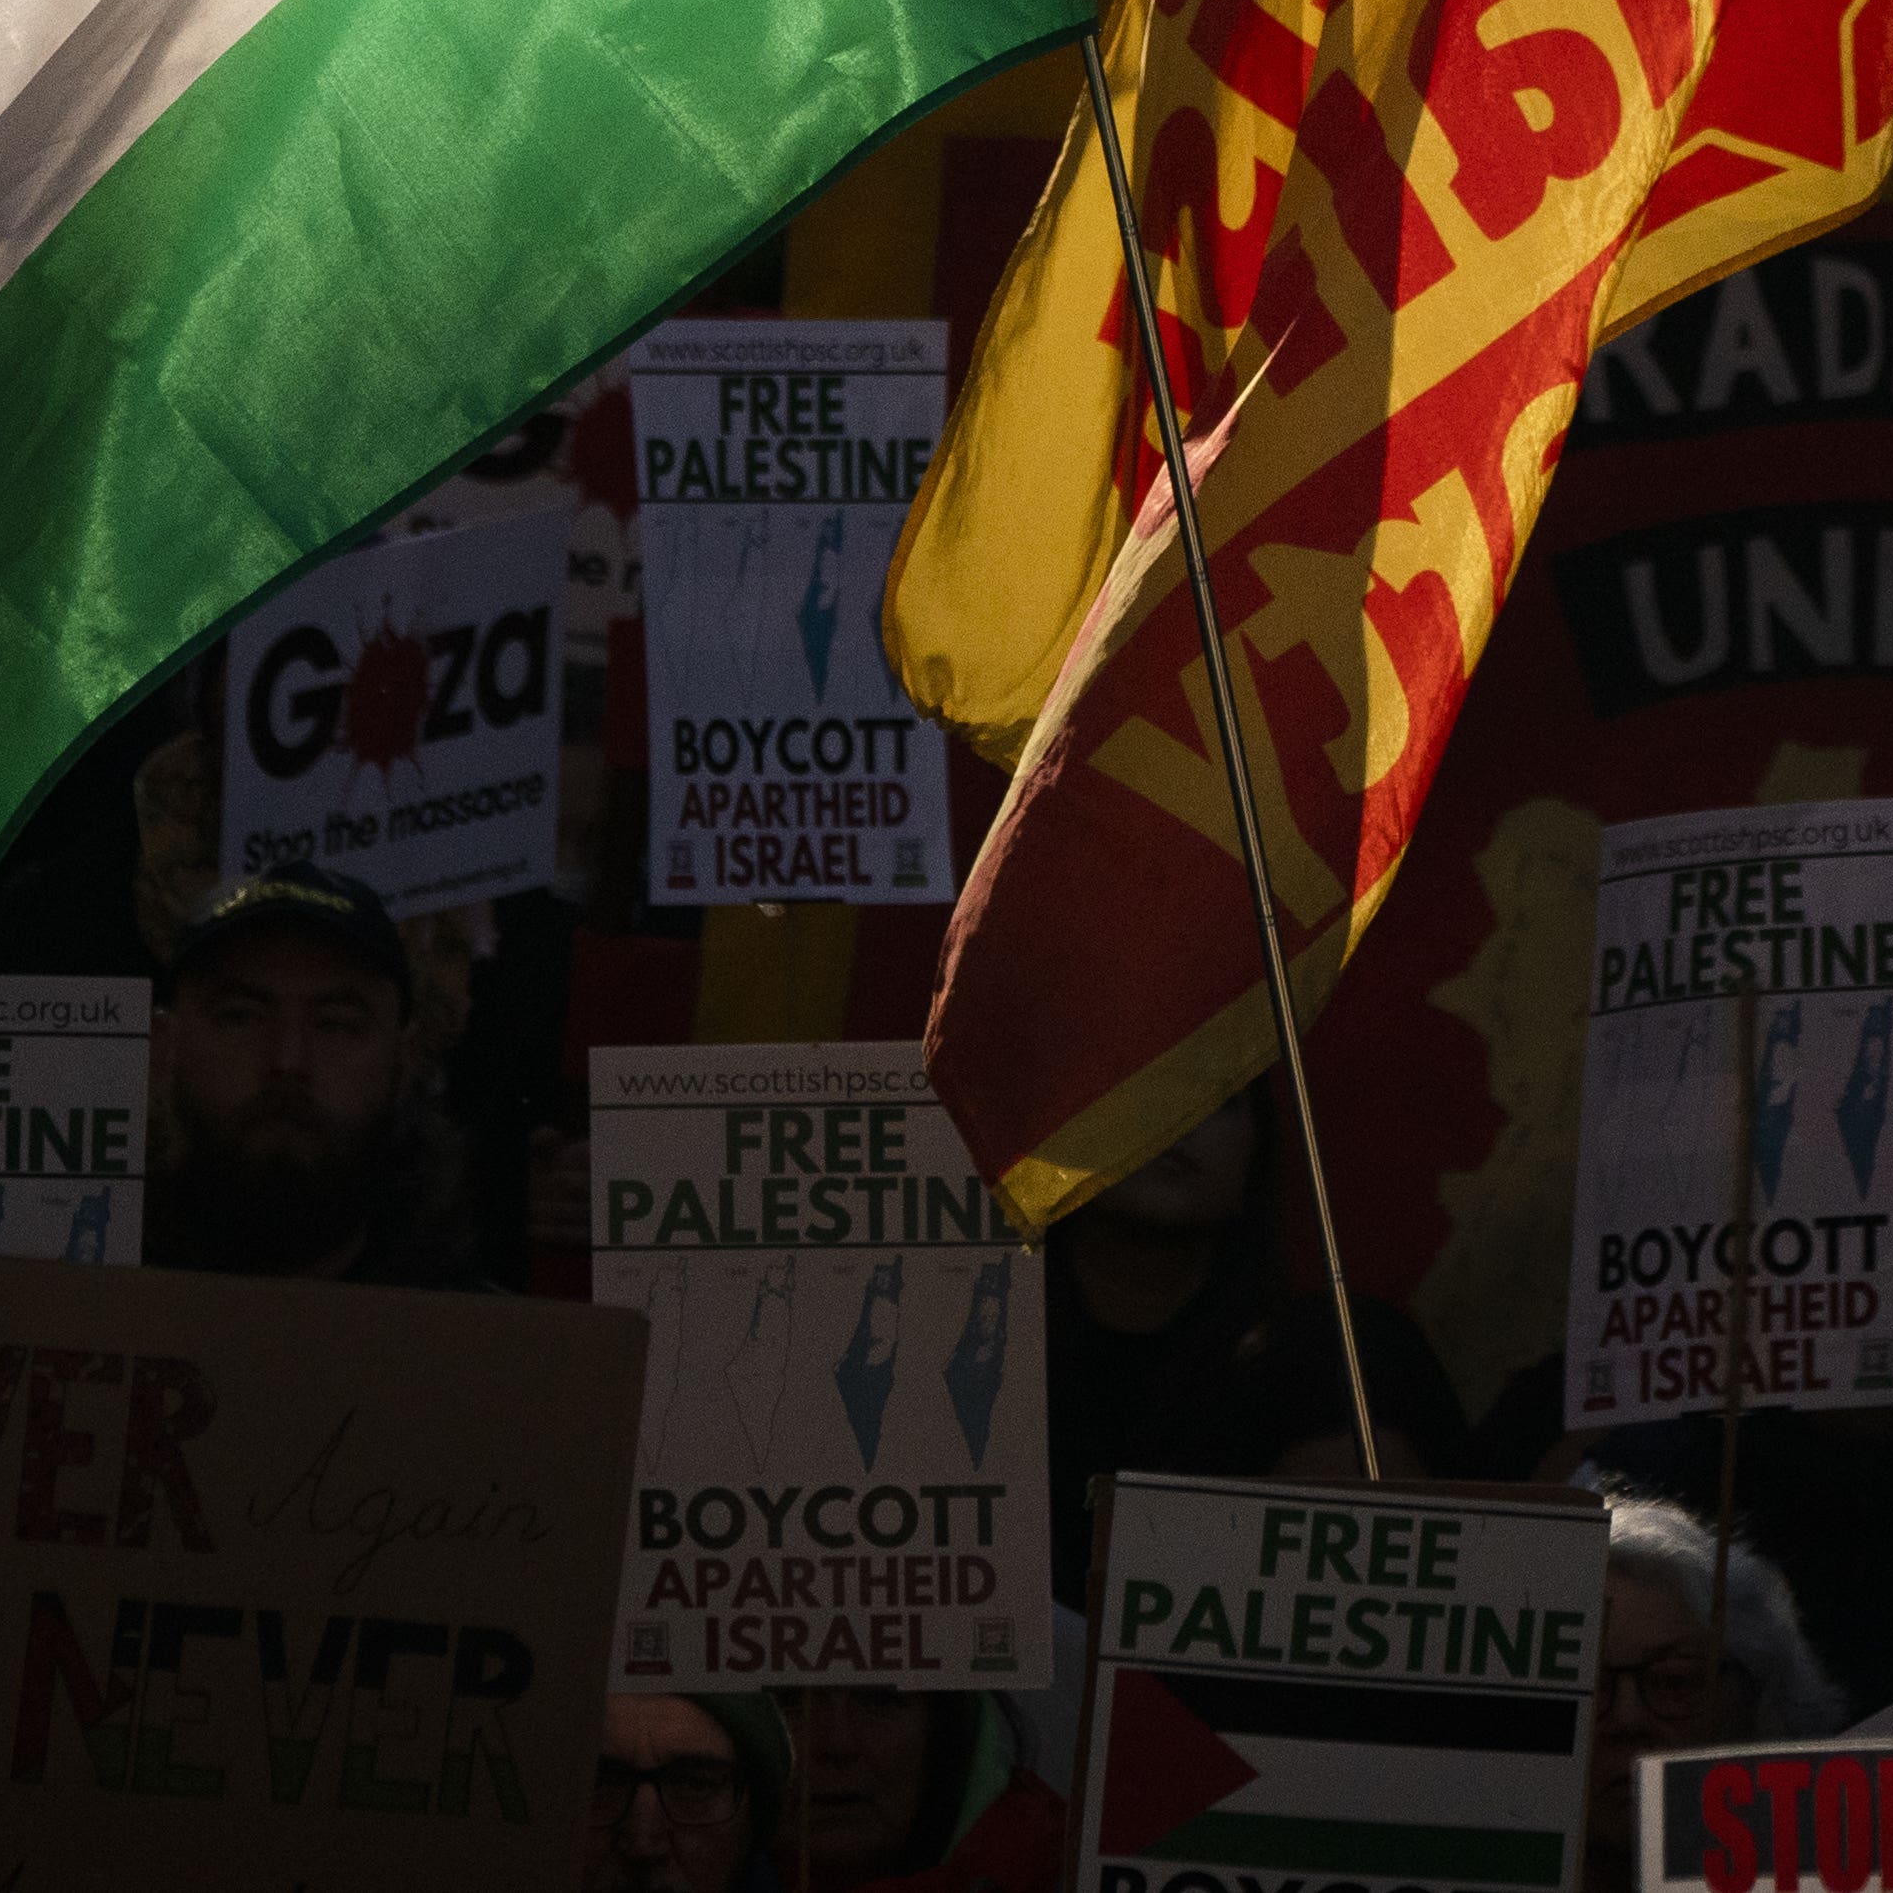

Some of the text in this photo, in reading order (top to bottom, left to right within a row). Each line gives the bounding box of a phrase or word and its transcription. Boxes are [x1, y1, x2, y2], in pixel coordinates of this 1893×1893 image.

[717, 374, 847, 437] FREE
[643, 437, 933, 503] PALESTINE
[246, 605, 552, 781] Gza
[673, 716, 917, 778] BOYCOTT
[325, 809, 378, 856] the
[388, 772, 546, 843] massacre
[678, 780, 914, 830] APARTHEID
[715, 833, 872, 889] ISRAEL
[1667, 861, 1805, 935] FREE
[618, 1062, 934, 1099] www.scottishpsc.o
[724, 1107, 907, 1176] FREE
[1598, 1213, 1889, 1293] BOYCOTT
[1639, 1337, 1831, 1404] ISRAEL
[246, 1402, 556, 1598] Again
[638, 1483, 1009, 1551] BOYCOTT
[647, 1555, 998, 1608] APARTHEID
[1256, 1505, 1463, 1591] FREE
[705, 1613, 942, 1673] ISRAEL
[1118, 1576, 1587, 1682] PALESTINE
[8, 1588, 536, 1826] NEVER
